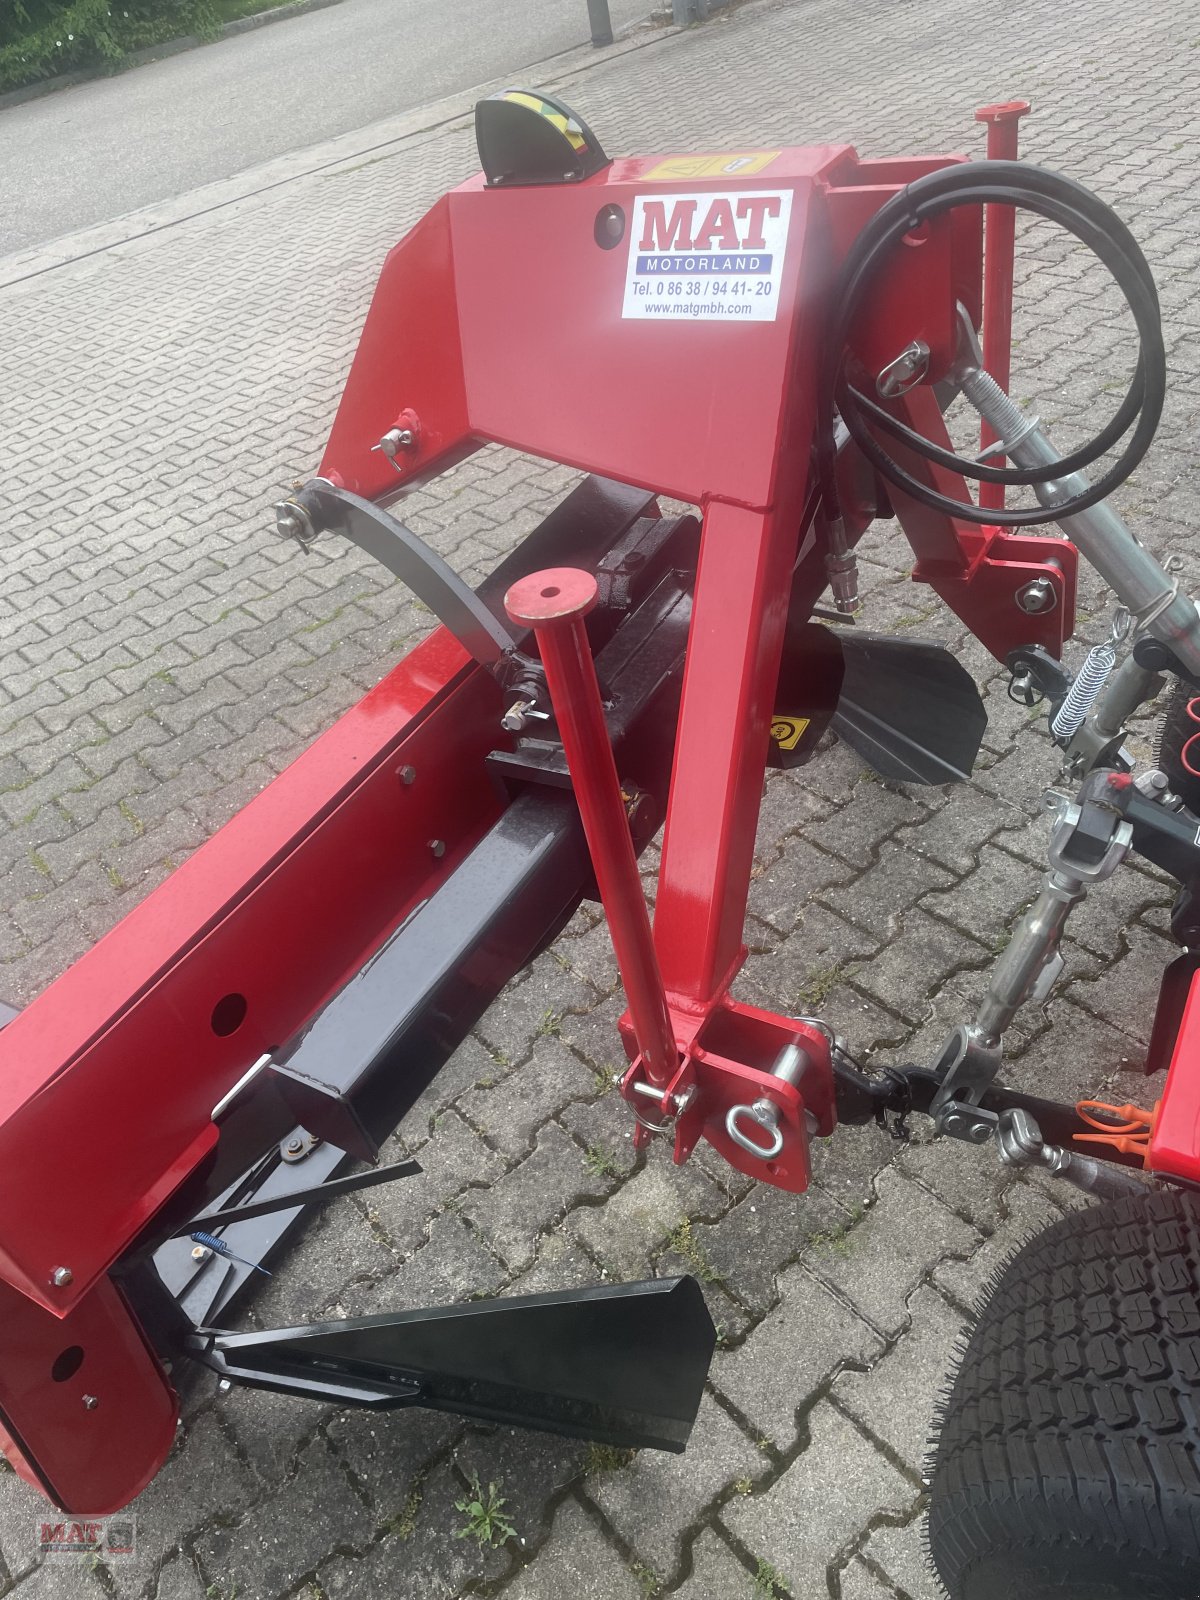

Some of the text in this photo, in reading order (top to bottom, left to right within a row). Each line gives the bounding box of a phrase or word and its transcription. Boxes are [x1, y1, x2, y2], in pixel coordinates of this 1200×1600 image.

[639, 197, 782, 251] MAT
[646, 257, 760, 271] MOTORLAND
[633, 281, 652, 296] Tel.
[657, 281, 664, 295] 0
[667, 281, 682, 295] 86
[686, 281, 701, 295] 38
[712, 281, 728, 296] 94
[755, 281, 772, 295] 20
[645, 301, 752, 317] www.matgmbh.com
